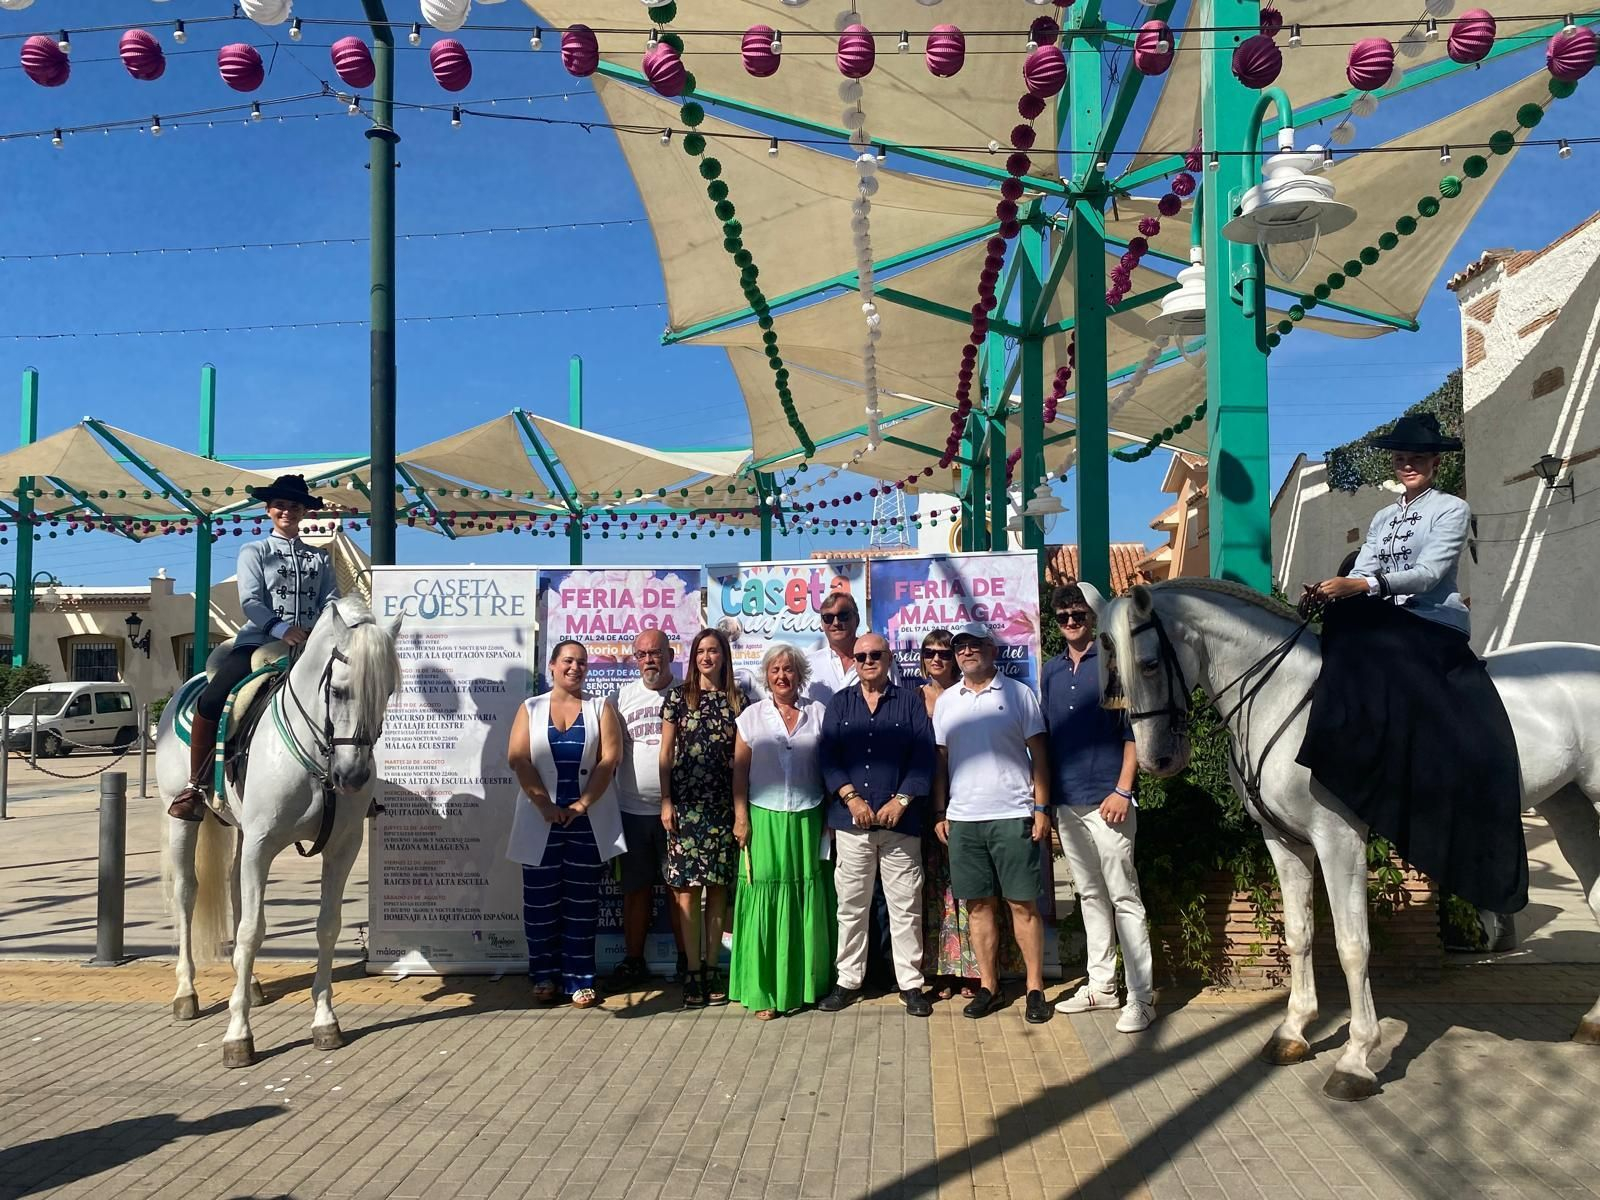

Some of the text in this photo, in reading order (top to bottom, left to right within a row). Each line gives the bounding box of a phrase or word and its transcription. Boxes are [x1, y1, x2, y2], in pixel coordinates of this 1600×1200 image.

[413, 578, 500, 596] CASETA
[895, 577, 1006, 600] FERIA DE
[561, 588, 676, 609] FERIA DE
[383, 594, 525, 620] ECUESTRE
[900, 600, 1009, 625] MÁLAGA
[565, 609, 678, 634] MÁLAGA
[743, 606, 824, 640] infan
[398, 649, 522, 661] MENAJE A LA EQUITACIÓN ESPAÑOLA
[587, 643, 619, 655] itorio
[1001, 645, 1024, 659] del
[587, 669, 605, 677] ADO
[429, 685, 439, 693] EN
[440, 685, 450, 693] LA
[451, 685, 471, 693] ALTA
[474, 685, 506, 693] ESCUELA
[385, 713, 497, 721] CONCURSO DE INDUMENTARIA
[385, 722, 391, 730] Y
[393, 722, 426, 731] ATALAJE
[418, 742, 456, 750] ECUESTRE
[384, 777, 513, 785] AIRES ALTO EN ESCUELA ECUESTRE
[384, 807, 430, 818] EQUITACIÓN
[384, 843, 421, 851] AMAZONA
[412, 878, 422, 886] DE
[423, 878, 434, 886] LA
[435, 878, 456, 886] ALTA
[457, 878, 490, 886] ESCUELA
[384, 911, 520, 923] HOMENAJE A LA EQUITACIÓN ESPAÑOLA
[376, 946, 406, 957] málaga
